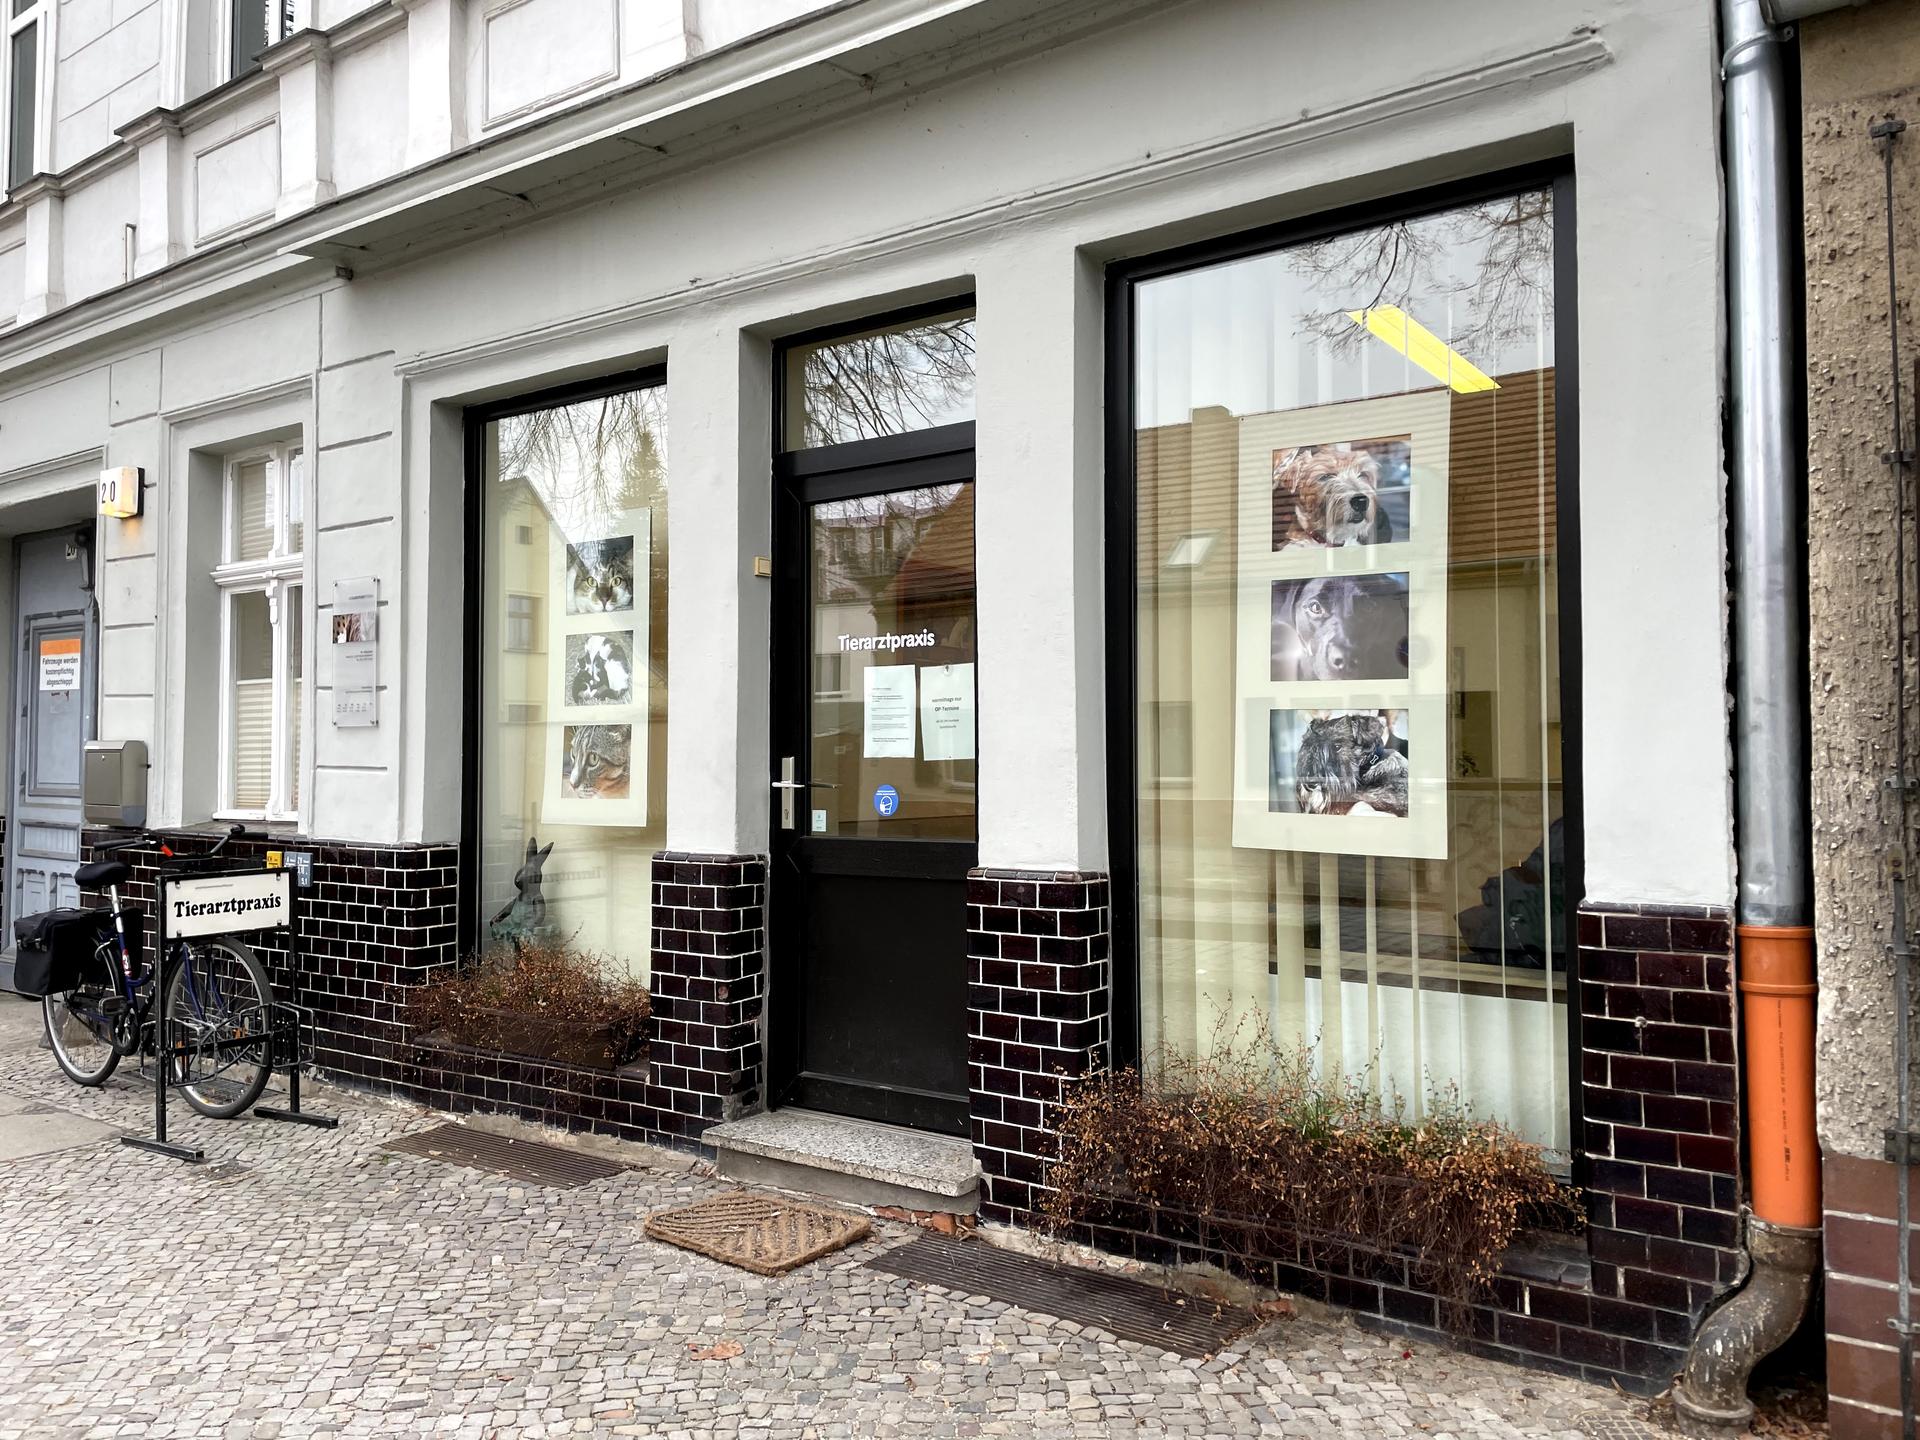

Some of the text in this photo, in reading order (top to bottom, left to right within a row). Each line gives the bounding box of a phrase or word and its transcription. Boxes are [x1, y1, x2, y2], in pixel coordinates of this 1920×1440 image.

[101, 480, 116, 504] 20
[66, 543, 76, 557] 20
[838, 628, 935, 652] Tierarztpraxis
[63, 656, 79, 664] werden
[174, 893, 281, 918] Tierarztpraxis
